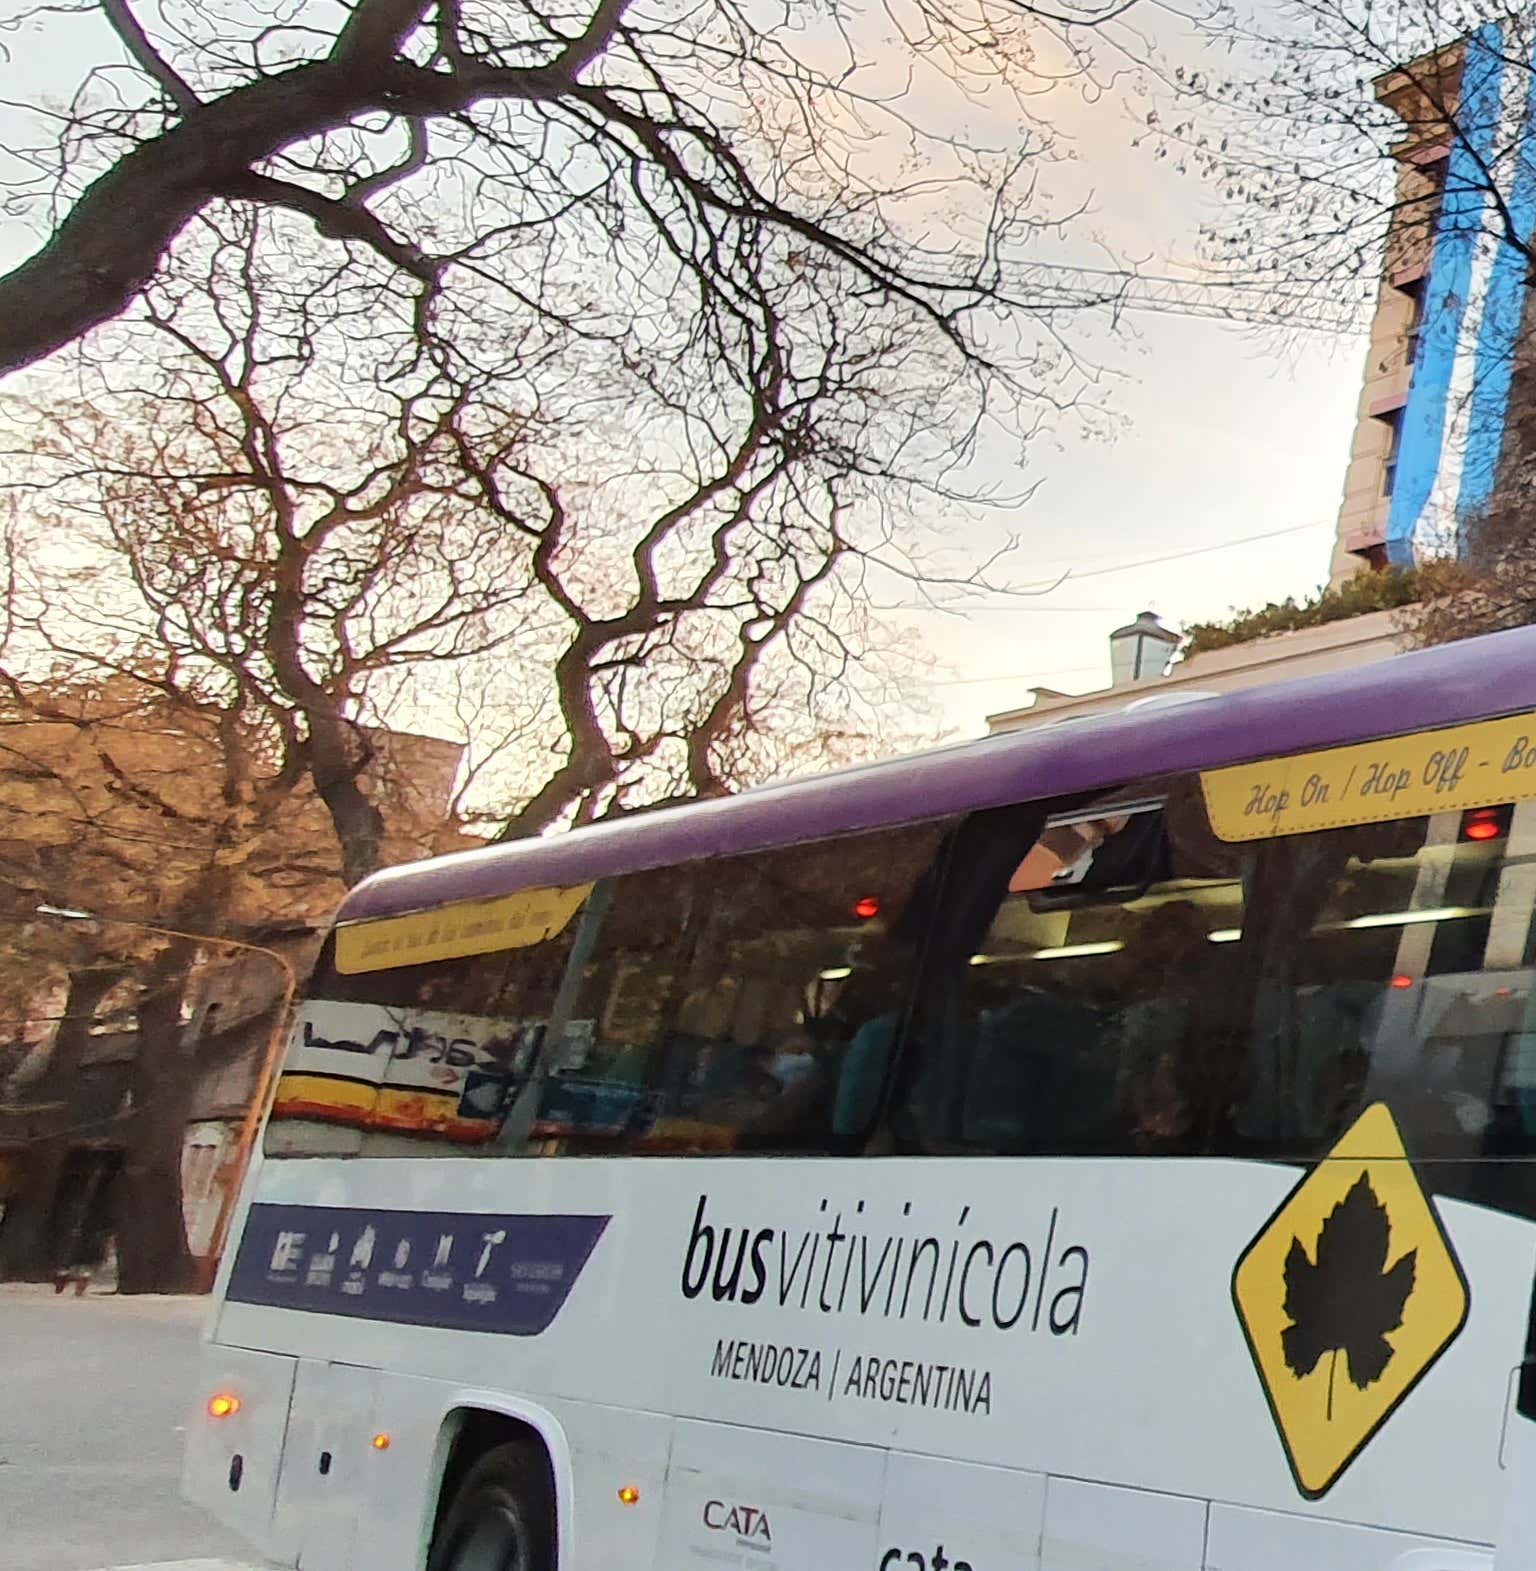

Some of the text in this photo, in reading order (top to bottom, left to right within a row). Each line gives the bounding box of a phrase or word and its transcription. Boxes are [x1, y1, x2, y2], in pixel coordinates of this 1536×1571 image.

[1244, 784, 1290, 822] Hop
[1300, 773, 1330, 807] On
[1360, 762, 1412, 802] Hop
[1422, 746, 1470, 794] Off
[711, 1339, 822, 1392] MENDOZA
[843, 1356, 992, 1416] ARGENTINA
[703, 1500, 771, 1541] CATA
